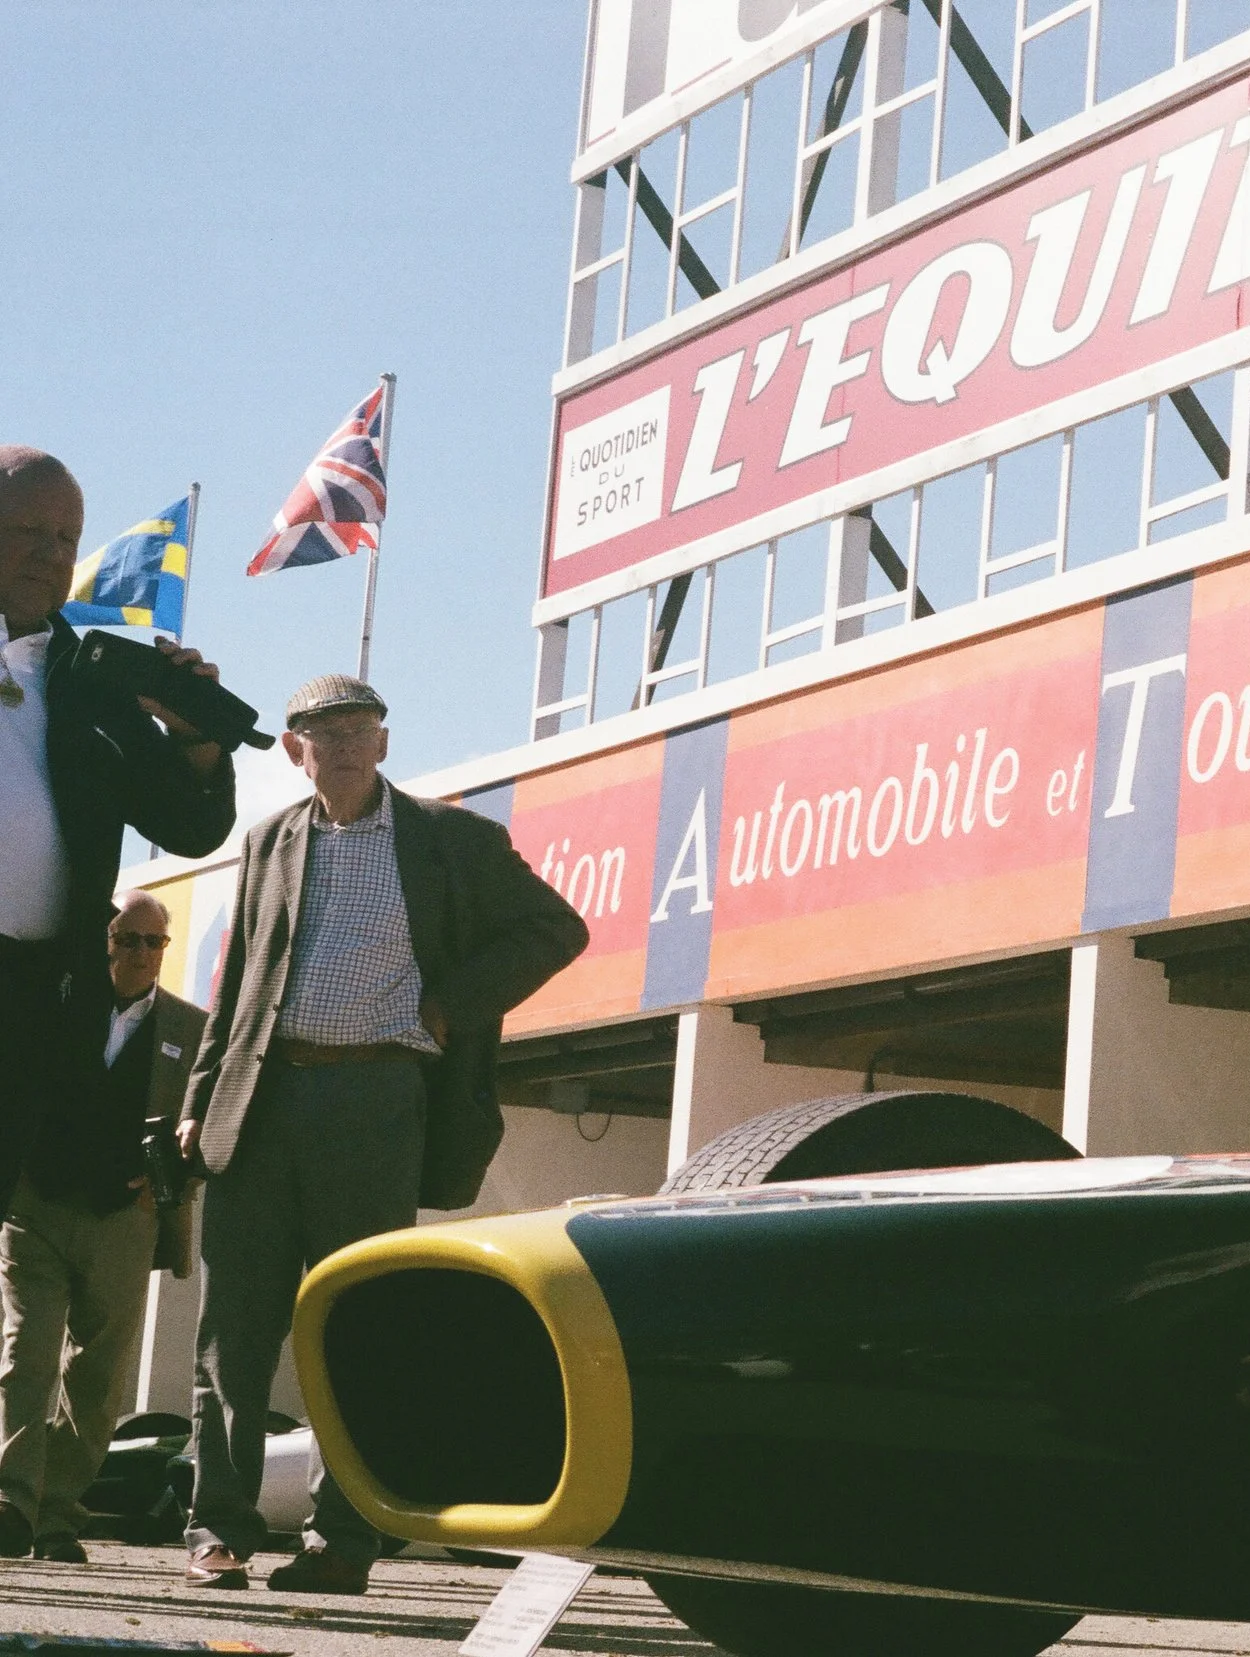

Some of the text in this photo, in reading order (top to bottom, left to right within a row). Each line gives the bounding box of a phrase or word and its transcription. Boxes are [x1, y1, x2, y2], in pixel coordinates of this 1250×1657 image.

[579, 418, 658, 472] QUOTIDIEN
[599, 463, 626, 486] DU
[576, 476, 645, 527] SPORT
[540, 837, 626, 918] tion
[650, 727, 1020, 924] Automobile
[1045, 750, 1086, 817] et
